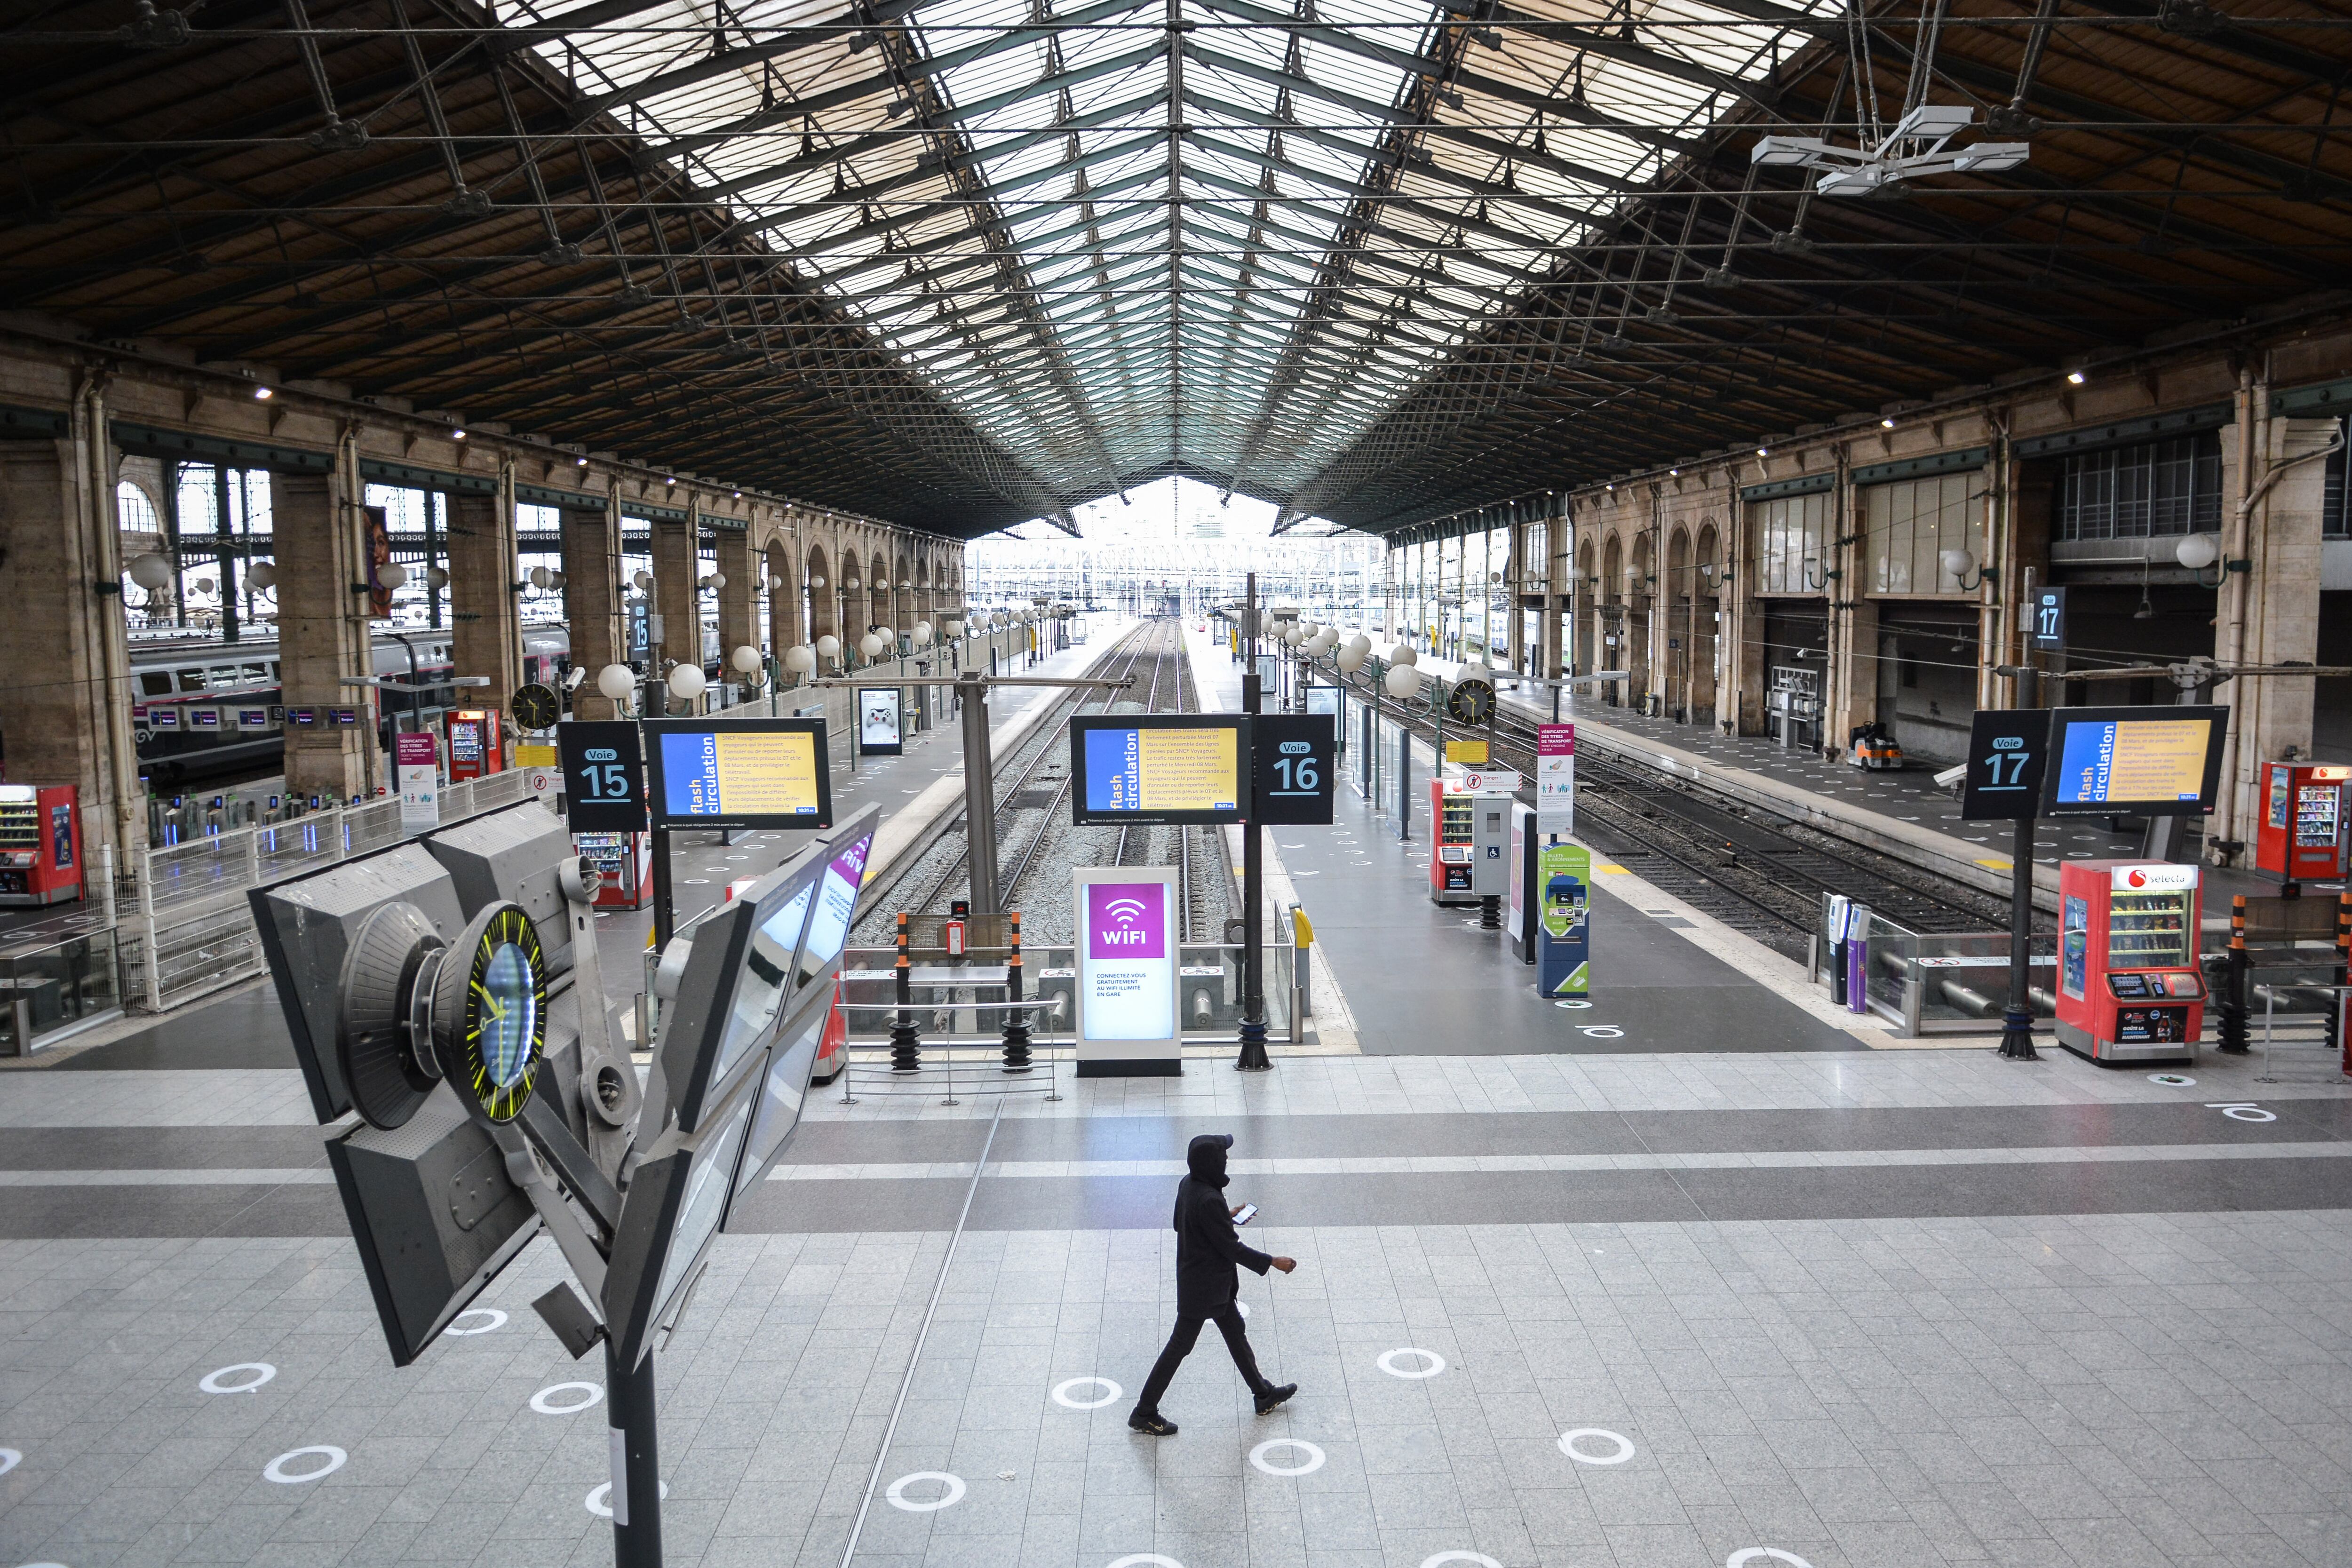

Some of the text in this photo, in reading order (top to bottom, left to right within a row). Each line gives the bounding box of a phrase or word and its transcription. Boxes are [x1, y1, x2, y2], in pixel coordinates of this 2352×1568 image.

[635, 619, 647, 645] 15
[2040, 608, 2058, 634] 17
[589, 750, 612, 759] Voie
[1283, 743, 1306, 752] Voie
[1997, 739, 2019, 748] Voie
[703, 736, 718, 814] circulation
[1125, 732, 1136, 810] circulation
[1273, 757, 1318, 789] 16
[1984, 753, 2029, 784] 17
[2093, 725, 2114, 801] circulation
[581, 765, 628, 796] 15
[1110, 775, 1122, 809] flash
[2077, 767, 2094, 802] flash
[689, 779, 704, 814] flash
